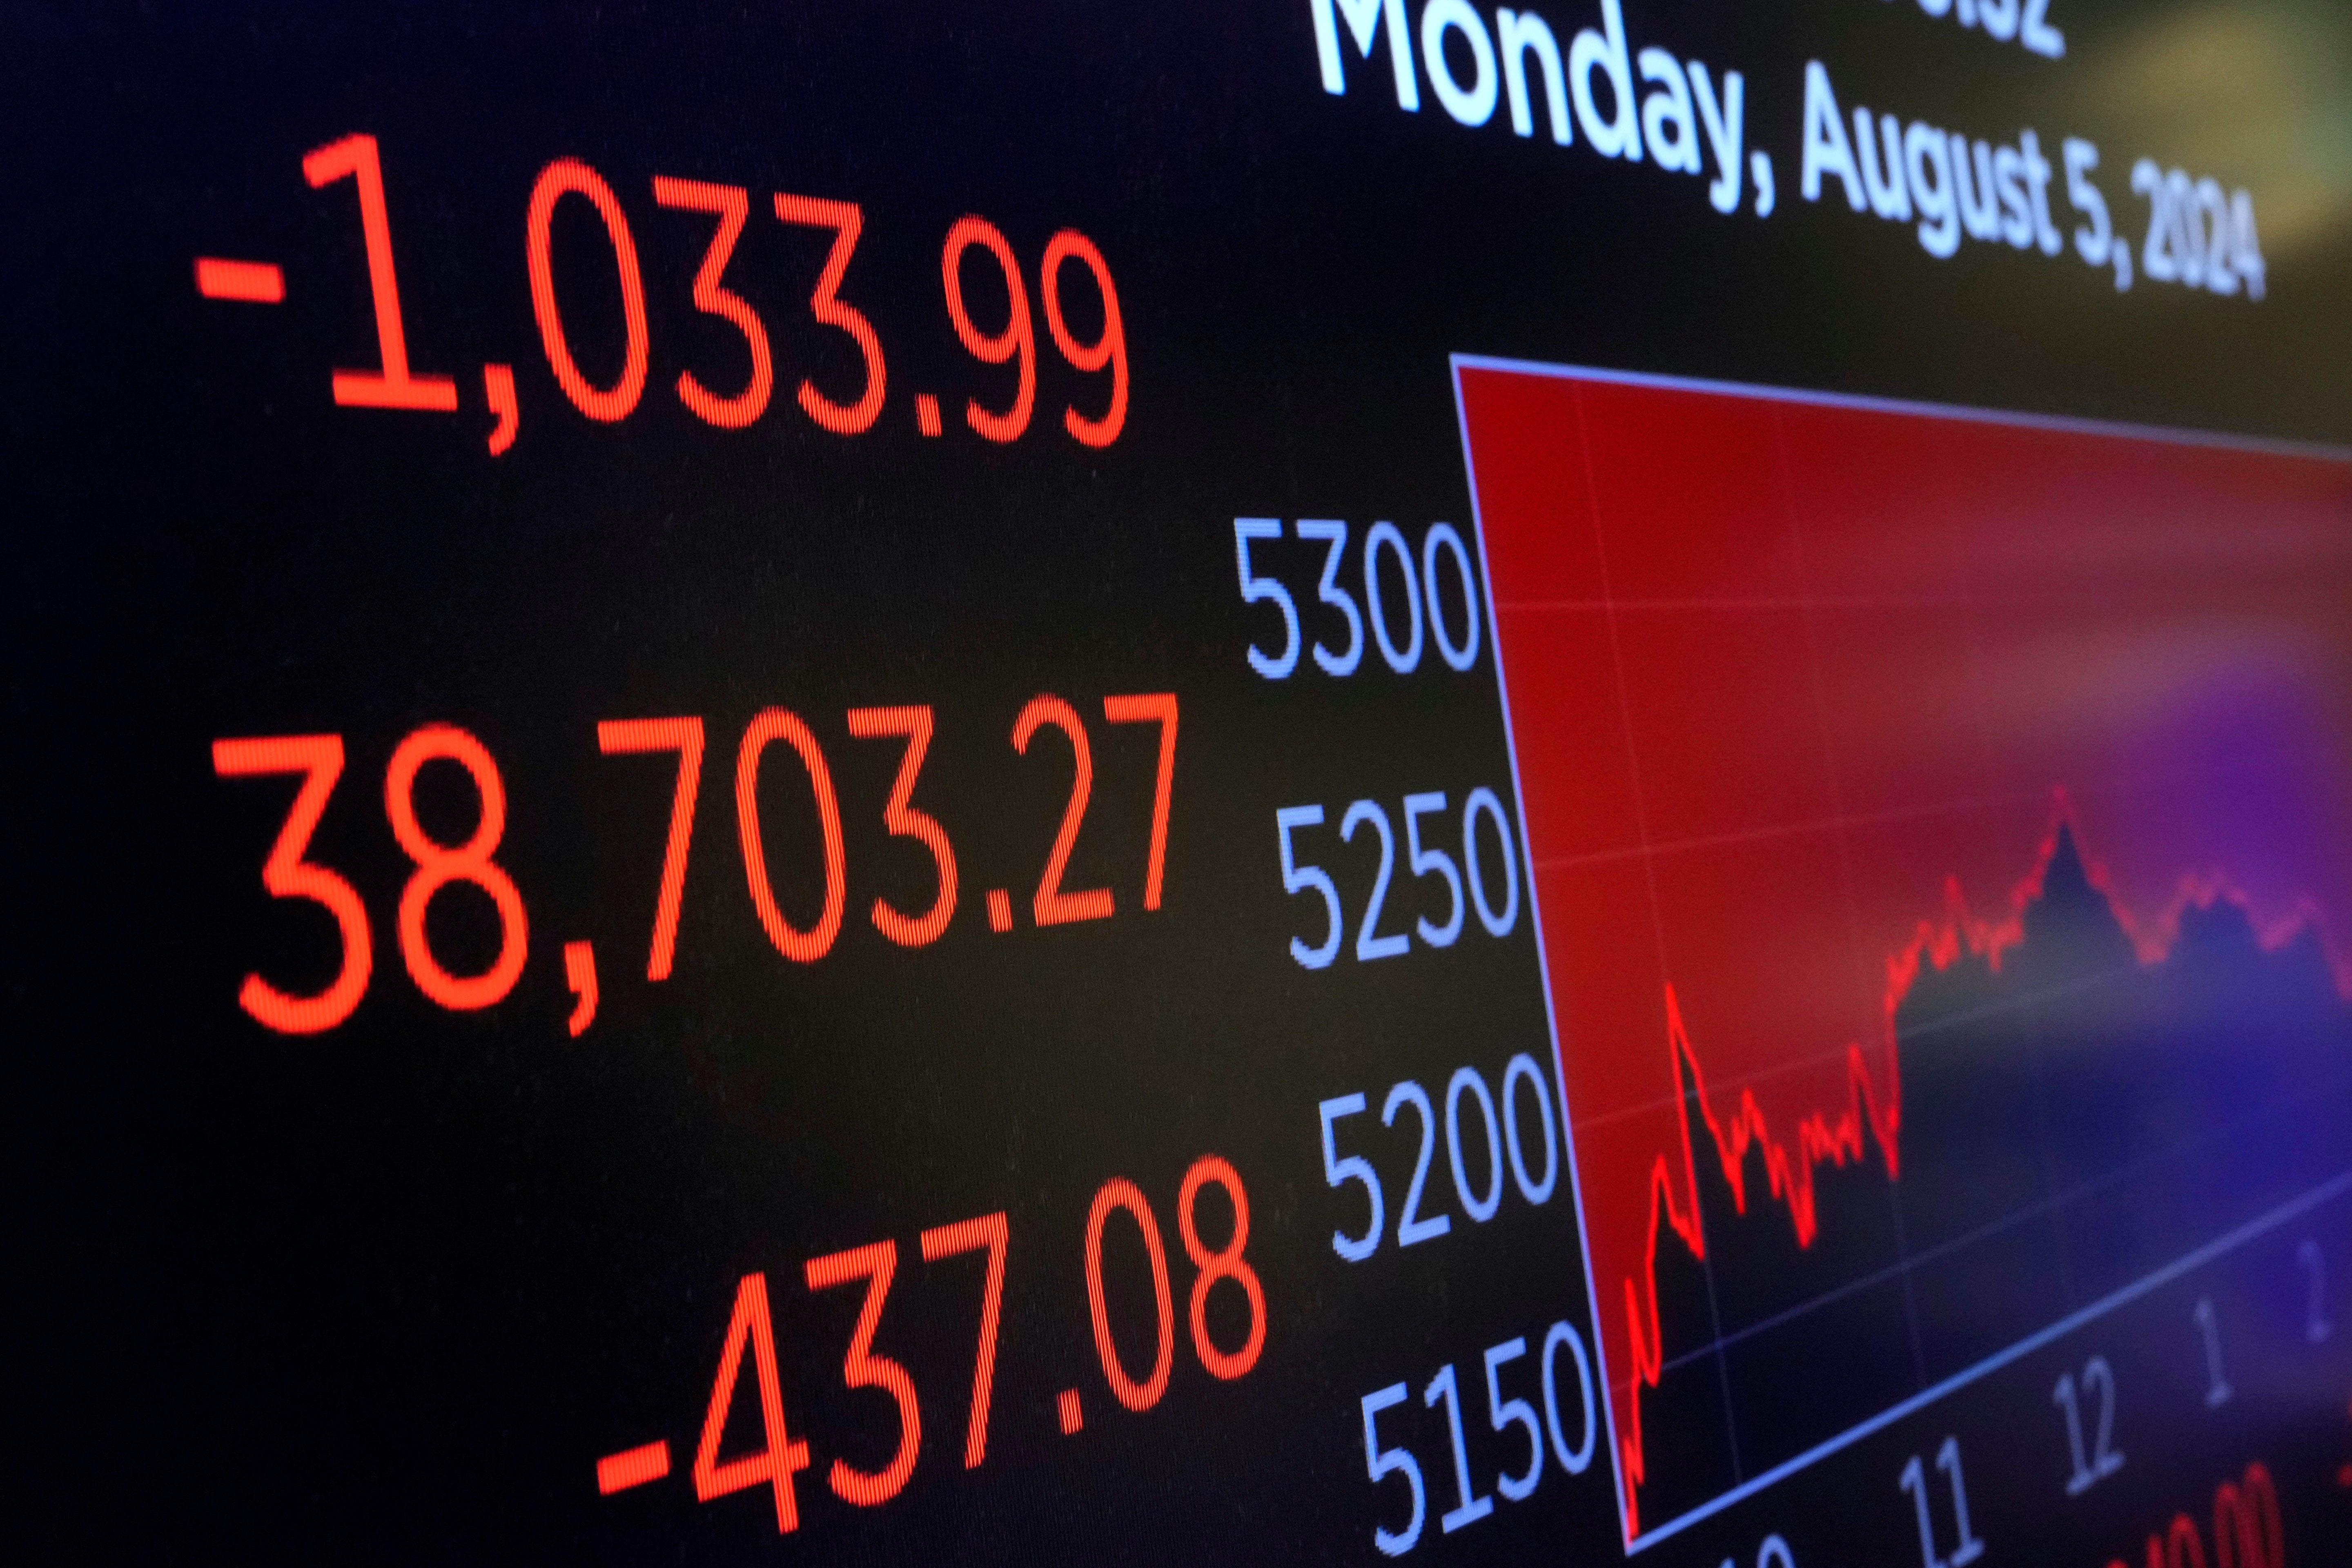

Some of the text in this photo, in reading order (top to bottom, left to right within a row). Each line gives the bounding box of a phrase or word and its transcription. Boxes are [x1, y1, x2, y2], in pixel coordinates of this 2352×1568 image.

[1310, 0, 2266, 301] Monday, August 5, 2024
[194, 132, 1130, 457] -1,033.99
[1233, 517, 1480, 679] 5300
[212, 692, 1180, 1038] 38,703.27
[1276, 787, 1520, 970] 5250
[1318, 1053, 1559, 1262] 5200
[596, 1154, 1268, 1535] -437.08
[1361, 1321, 1596, 1557] 5150
[1899, 1436, 1984, 1568] 11
[2052, 1356, 2124, 1494] 12
[2192, 1298, 2234, 1407] 1
